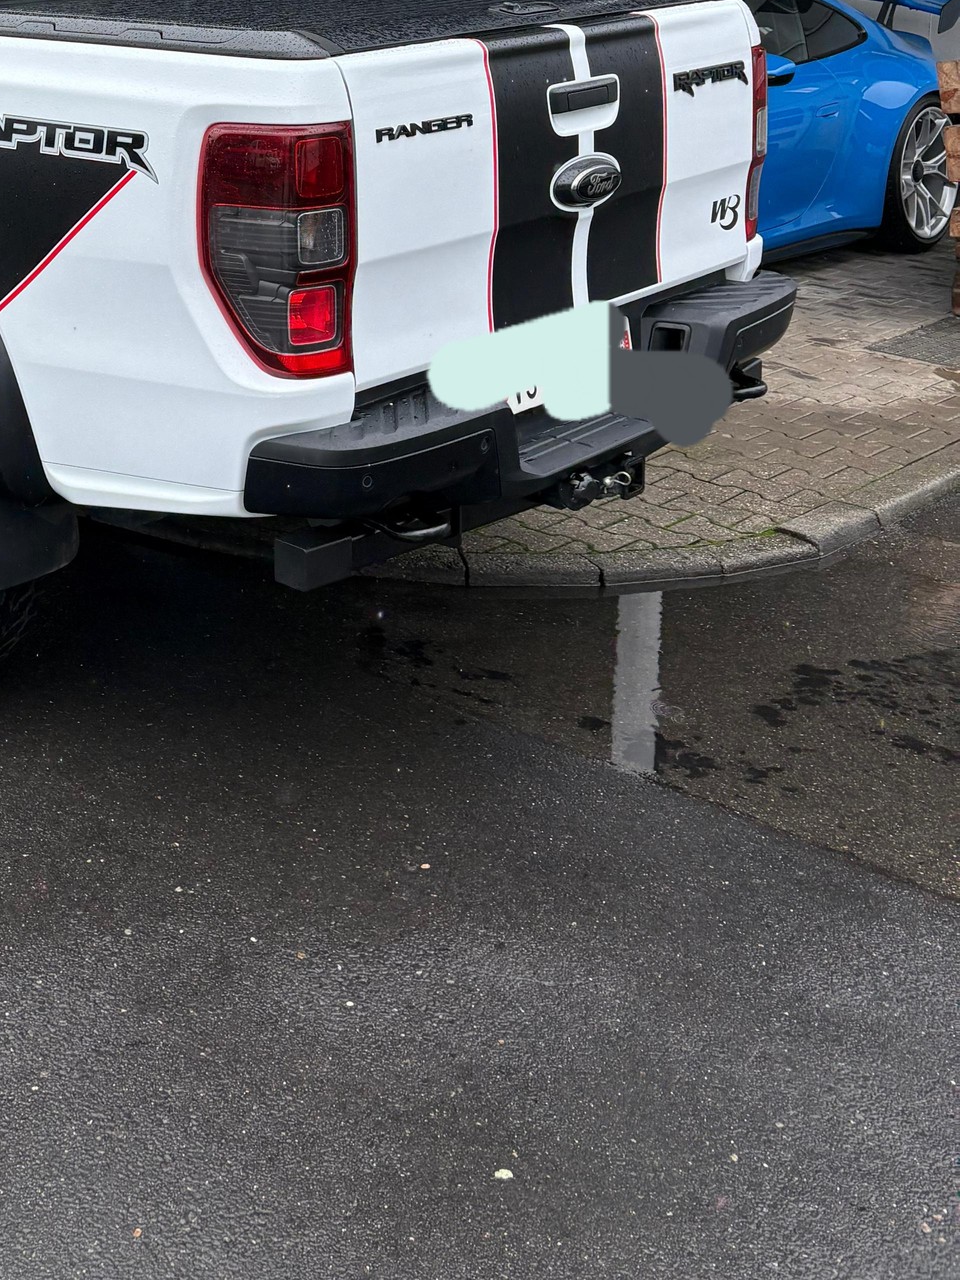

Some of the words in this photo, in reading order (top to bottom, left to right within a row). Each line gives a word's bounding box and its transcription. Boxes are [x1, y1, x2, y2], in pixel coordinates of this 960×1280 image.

[673, 60, 749, 98] RAPTOR
[375, 113, 474, 144] RANGER
[587, 172, 618, 196] Ford
